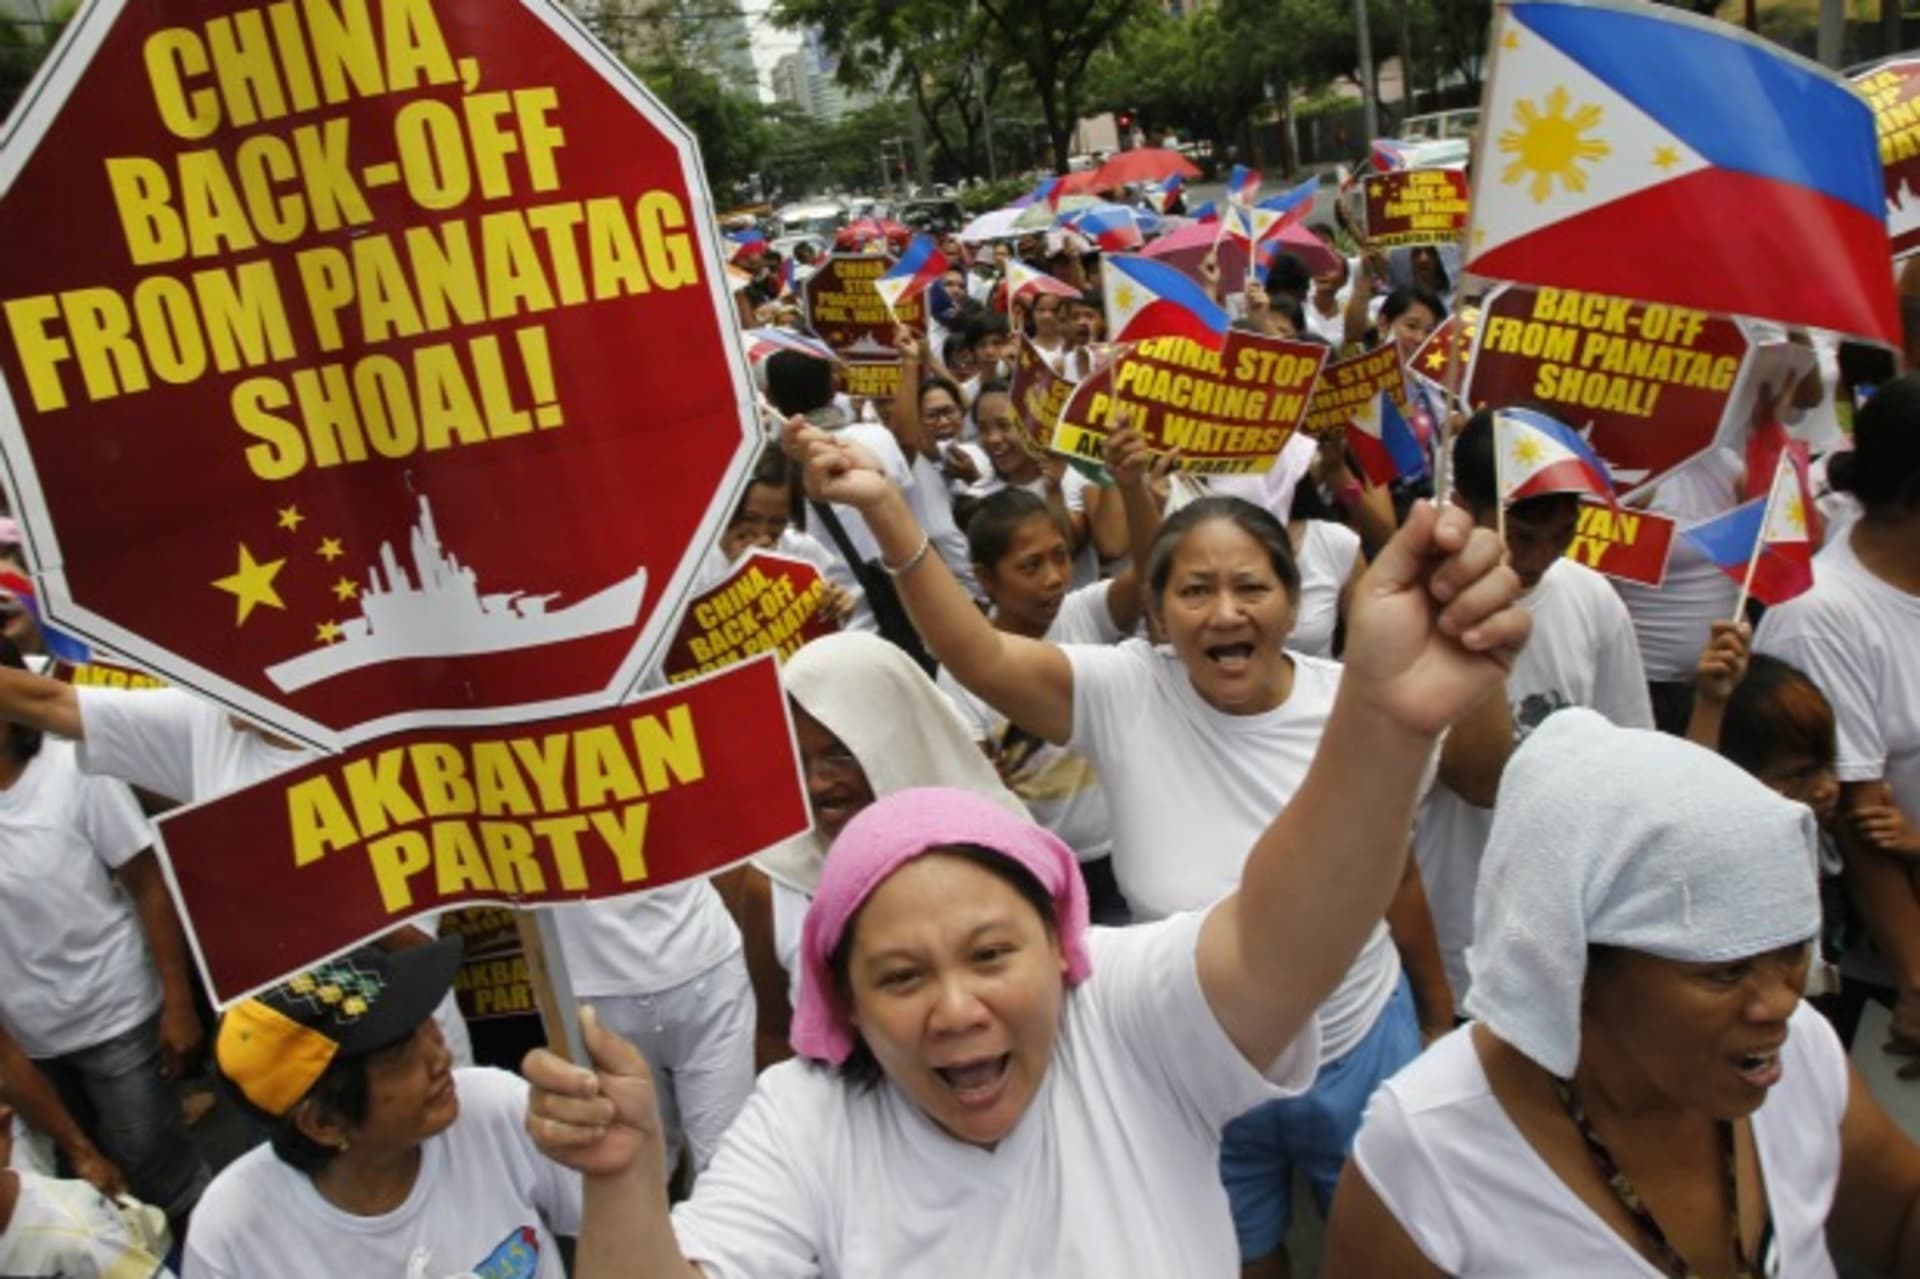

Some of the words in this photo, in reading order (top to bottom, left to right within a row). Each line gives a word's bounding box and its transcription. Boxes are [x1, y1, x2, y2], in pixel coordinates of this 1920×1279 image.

[143, 0, 480, 139] CHINA,
[105, 87, 567, 266] BACK-OFF
[4, 260, 298, 413] FROM
[295, 190, 698, 351] PANATAG
[1533, 286, 1708, 347] BACK-OFF
[1234, 346, 1318, 389] STOP
[1337, 348, 1396, 385] STOP
[1484, 316, 1579, 365] FROM
[1580, 332, 1739, 392] PANATAG
[231, 325, 564, 482] SHOAL!
[1115, 360, 1266, 422] POACHING
[1267, 390, 1305, 422] IN
[1534, 362, 1661, 418] SHOAL!
[1162, 412, 1292, 453] WATERS!
[693, 565, 774, 630] CHINA,
[285, 703, 704, 869] AKBAYAN
[366, 801, 650, 914] PARTY
[452, 956, 528, 991] AKBA
[475, 984, 531, 1015] PAR
